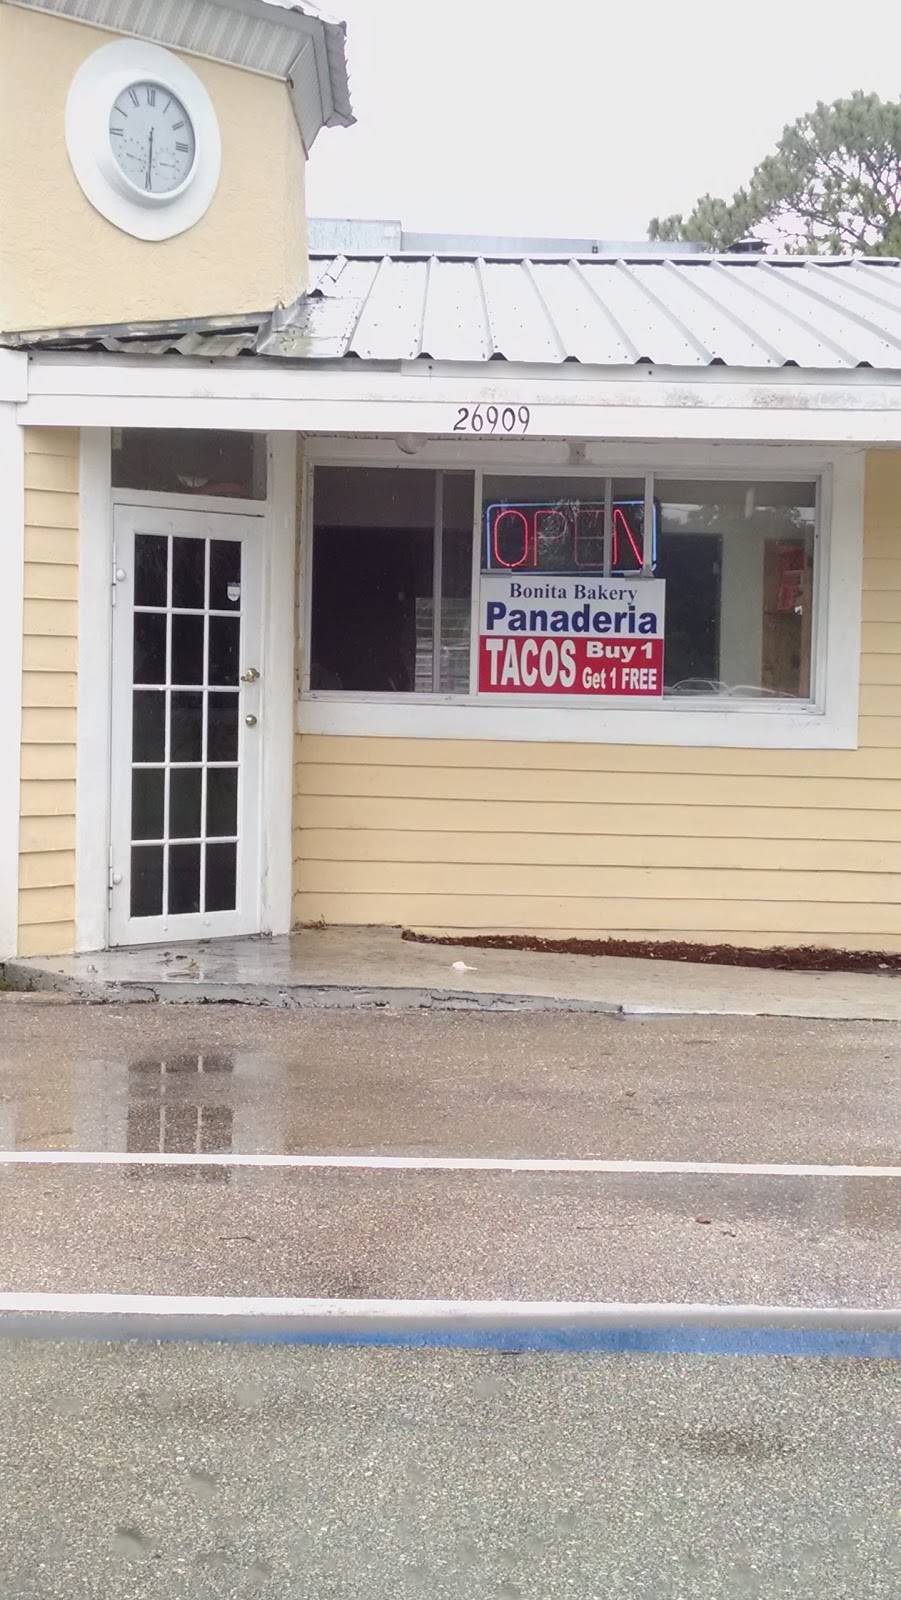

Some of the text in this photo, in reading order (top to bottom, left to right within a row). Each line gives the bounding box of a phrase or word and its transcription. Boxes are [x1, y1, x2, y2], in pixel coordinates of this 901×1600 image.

[453, 403, 530, 434] 26909
[494, 508, 648, 567] OPEN
[509, 582, 638, 606] Bonita Bakery
[486, 601, 658, 635] Panaderia
[485, 638, 577, 688] TACOS
[586, 641, 653, 663] Buy 1
[582, 666, 657, 690] Get 1 FREE
